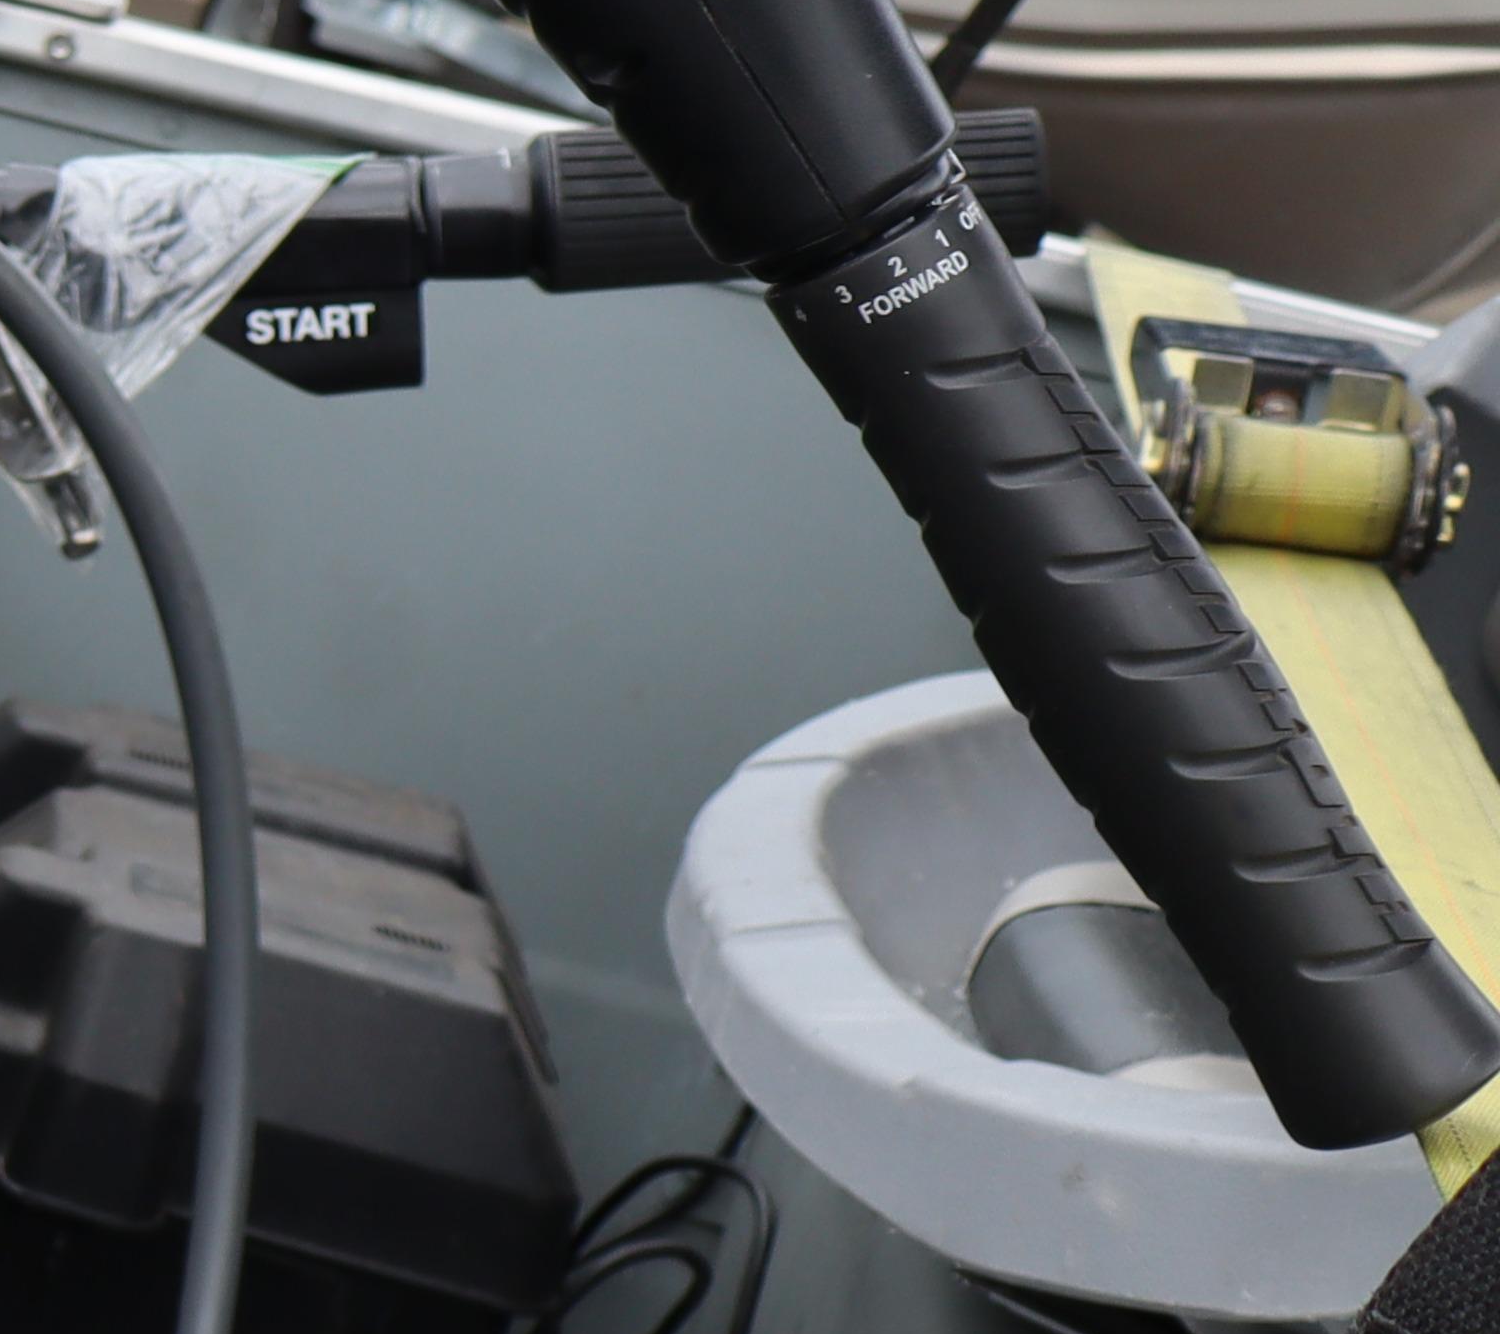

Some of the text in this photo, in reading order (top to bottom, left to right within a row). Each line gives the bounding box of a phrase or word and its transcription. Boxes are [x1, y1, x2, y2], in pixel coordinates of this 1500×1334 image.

[835, 285, 852, 303] 3
[888, 256, 907, 277] 2
[935, 229, 950, 247] 1
[858, 250, 970, 324] FORWARD
[246, 303, 375, 345] START
